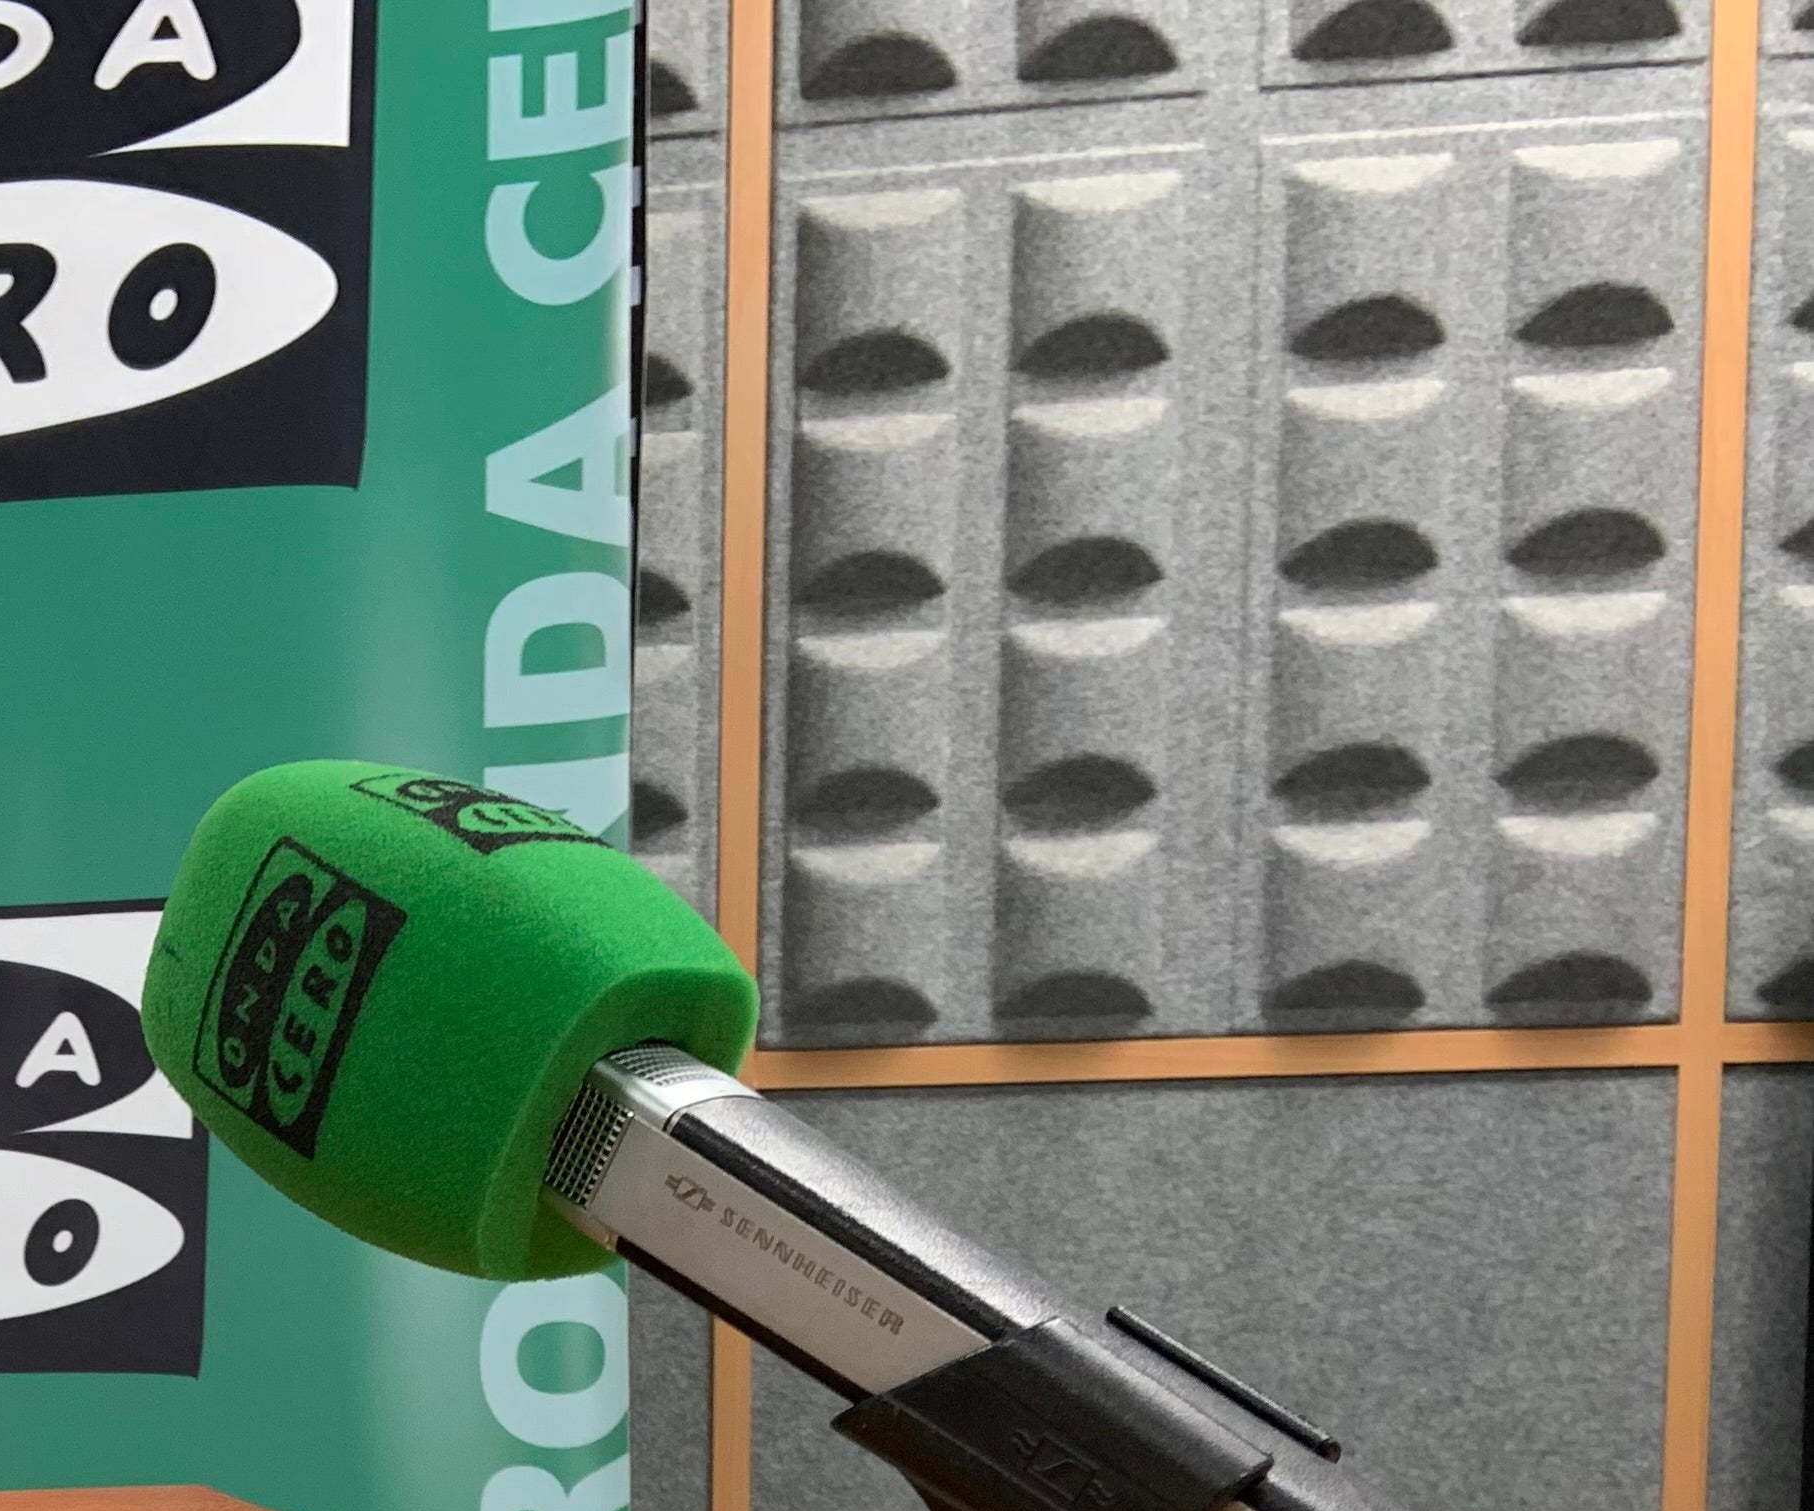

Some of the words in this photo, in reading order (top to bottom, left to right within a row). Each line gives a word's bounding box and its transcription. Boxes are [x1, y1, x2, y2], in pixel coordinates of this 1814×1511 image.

[484, 0, 635, 306] CE
[222, 898, 299, 1069] ONDA
[272, 924, 353, 1094] CERO
[719, 1205, 904, 1336] SENNHEISER
